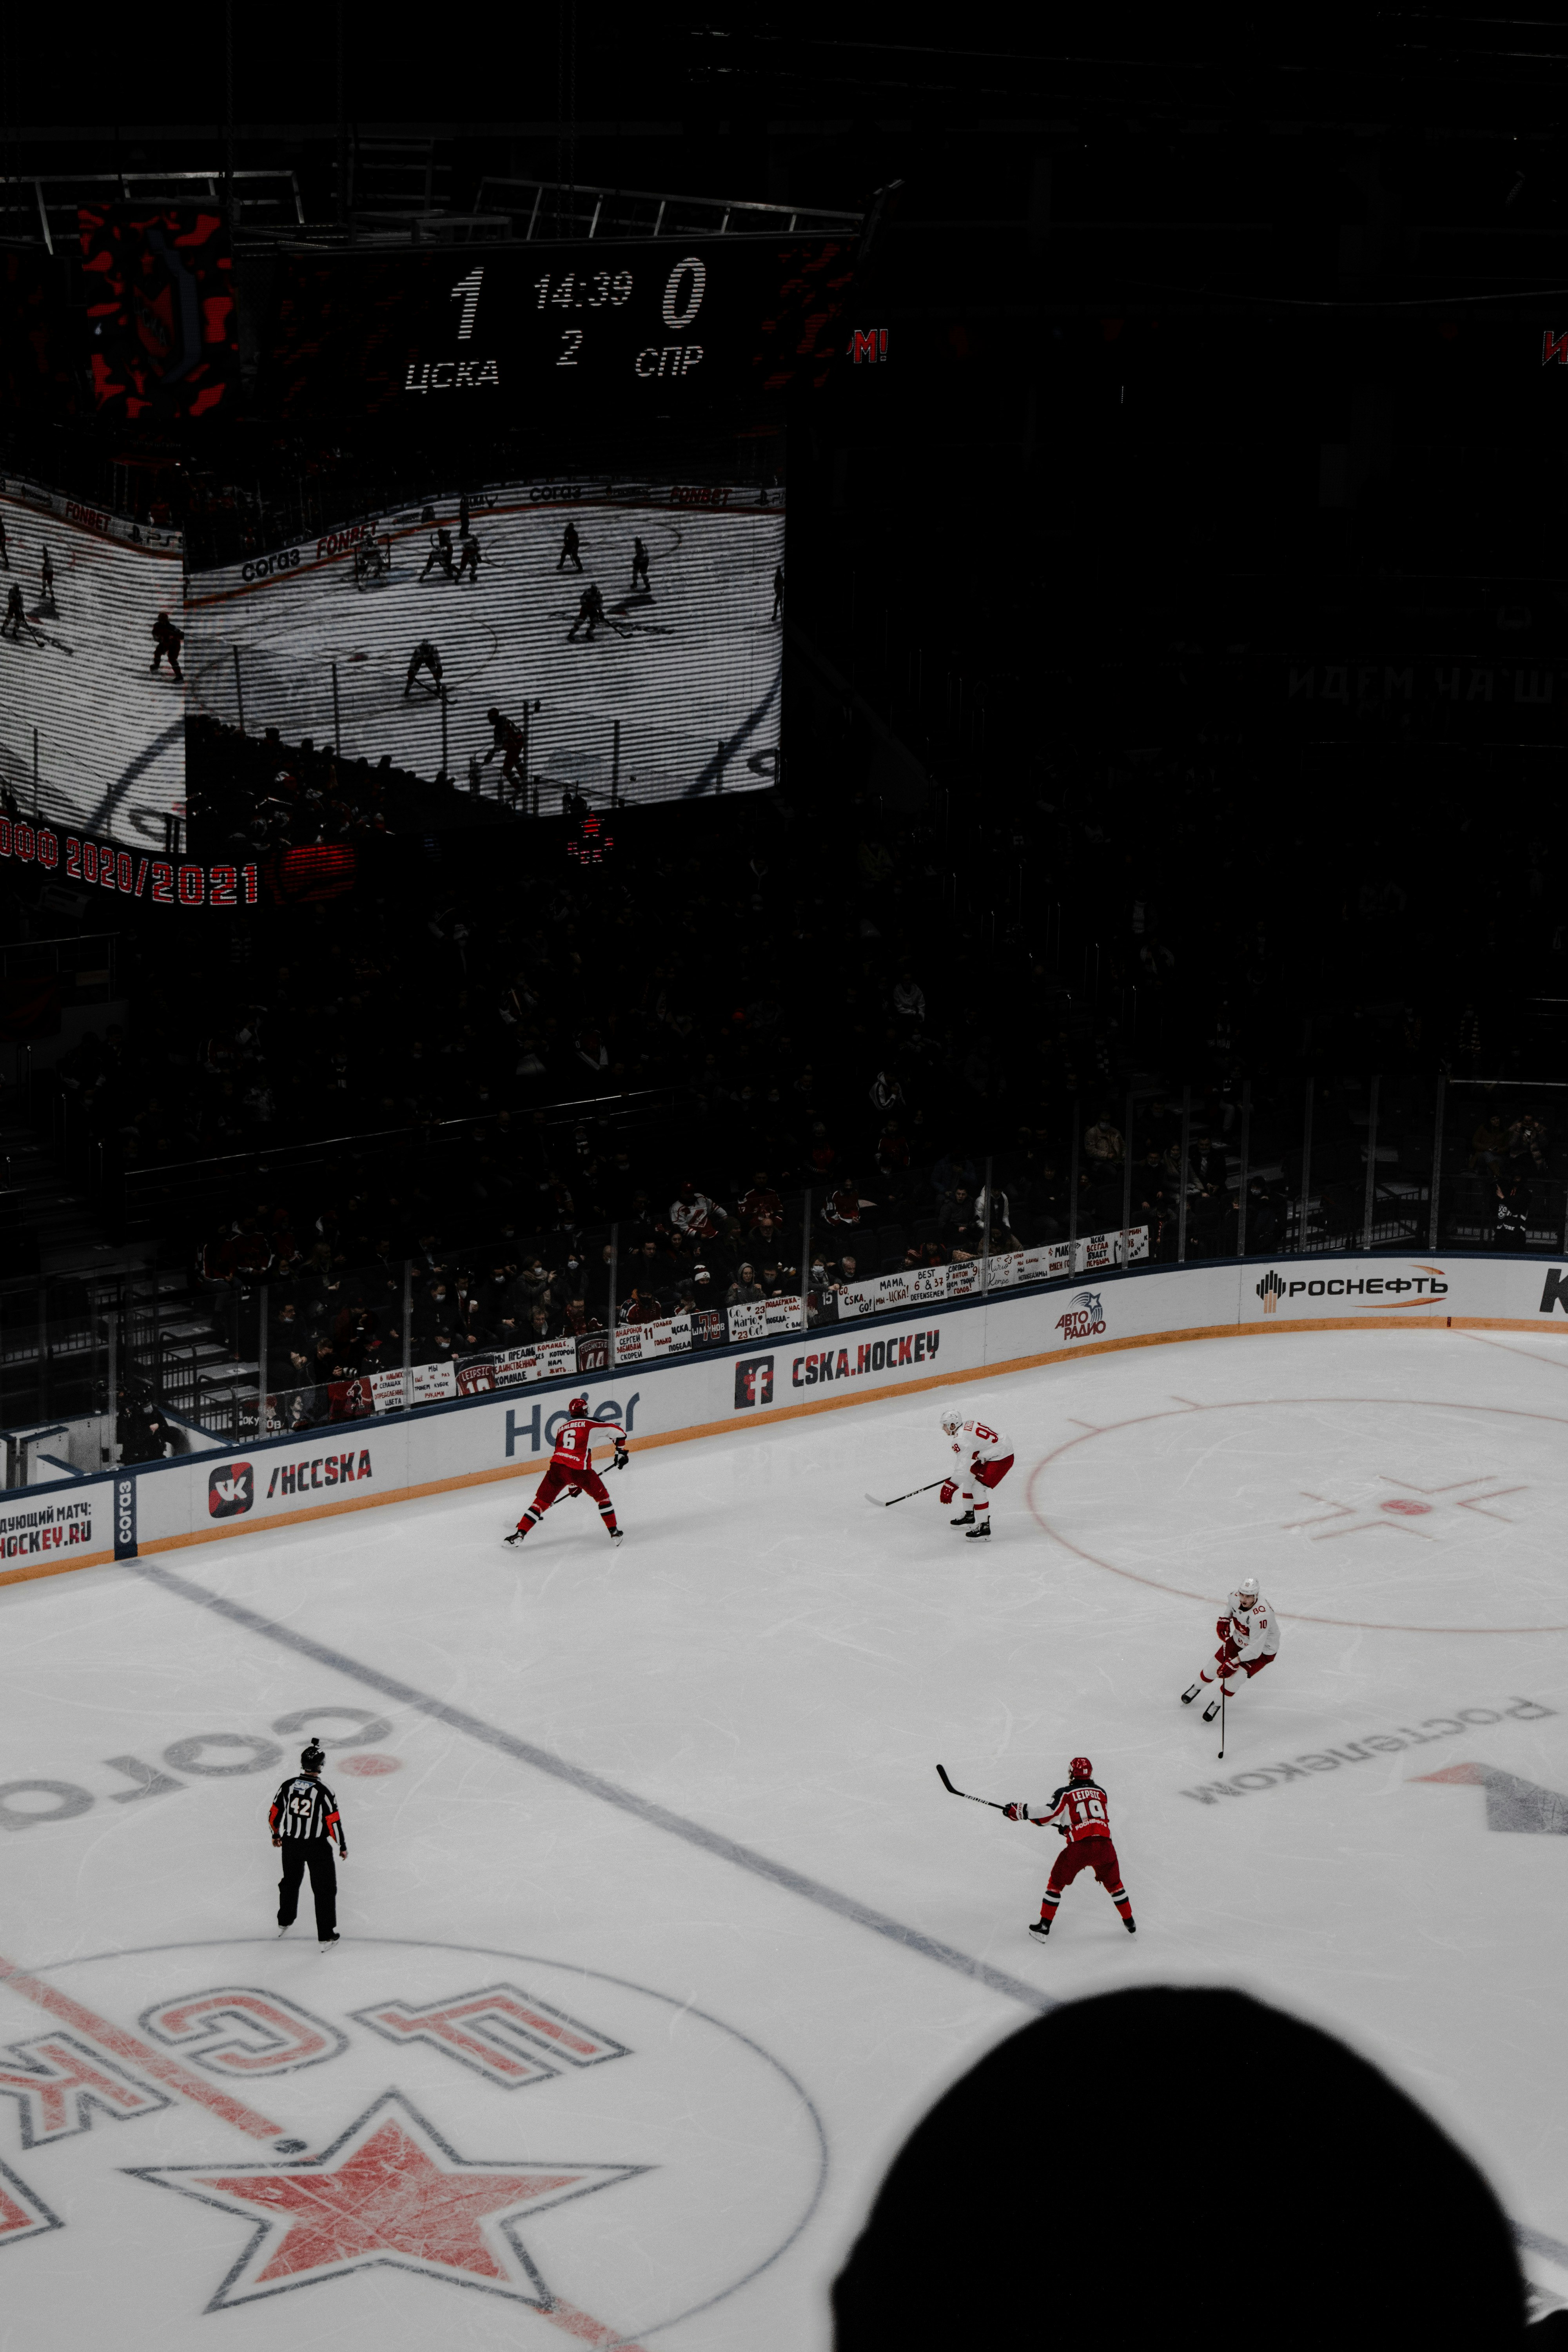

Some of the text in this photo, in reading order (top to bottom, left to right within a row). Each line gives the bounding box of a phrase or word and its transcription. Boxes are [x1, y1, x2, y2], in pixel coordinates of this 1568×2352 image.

[533, 271, 633, 309] 14:39
[662, 257, 705, 329] 0
[451, 266, 484, 339] 1
[555, 329, 583, 366] 2
[846, 329, 888, 363] М!
[635, 346, 703, 376] СПР
[406, 359, 499, 394] ЦСКА
[670, 487, 733, 506] FONBET
[66, 501, 111, 532] FONBET
[1514, 668, 1568, 704] Ш
[65, 837, 258, 905] 2020/2021
[1091, 1235, 1105, 1244] ЦСКА
[1087, 1242, 1108, 1252] ВСЕГДА
[1088, 1250, 1107, 1260] БУДЕТ
[1087, 1258, 1109, 1267] ПЕРВЫМ
[918, 1269, 935, 1279] BEST
[953, 1271, 968, 1279] АНТОН
[973, 1266, 978, 1276] 9
[1018, 1271, 1047, 1281] НЕПОБЕДИМЫ
[915, 1278, 943, 1290] 6 & 37
[1289, 1278, 1448, 1297] РОСНЕФТЬ
[822, 1290, 833, 1305] 15
[911, 1290, 944, 1301] DEFENSEMEN
[755, 1306, 765, 1314] 23
[859, 1299, 872, 1313] GO!
[653, 1320, 672, 1329] ТОЛЬКО
[1055, 1310, 1088, 1329] АВТО
[616, 1326, 653, 1340] АНДРОНОВ 11
[699, 1313, 720, 1341] 78
[1064, 1320, 1106, 1340] РАДИО
[619, 1334, 640, 1345] СЕРГЕЙ
[654, 1337, 671, 1347] ТОЛЬКО
[738, 1331, 748, 1339] 23
[550, 1347, 575, 1357] КОТОРОЙ
[581, 1341, 608, 1354] SOSHNIKO
[668, 1341, 691, 1352] ПОБЕДА
[495, 1354, 505, 1364] МЫ
[621, 1350, 642, 1361] СКОРЕЙ
[793, 1329, 940, 1388] CSKA.HOCKEY
[386, 1372, 403, 1380] НАШИХ
[462, 1367, 490, 1381] LEIPSIC
[495, 1371, 527, 1386] КОМАНДЕ
[379, 1380, 401, 1389] СЕРДЦАХ
[385, 1398, 401, 1406] ЦВЕТА
[506, 1392, 640, 1457] Haer
[563, 1429, 576, 1450] 6
[976, 1422, 998, 1443] 9
[267, 1449, 372, 1499] /HCCSKA
[57, 1502, 91, 1522] МАТЧ:
[1259, 1620, 1267, 1629] 10
[1072, 1790, 1100, 1802] LEIPSIC
[290, 1797, 311, 1817] 42
[1076, 1800, 1105, 1821] 19
